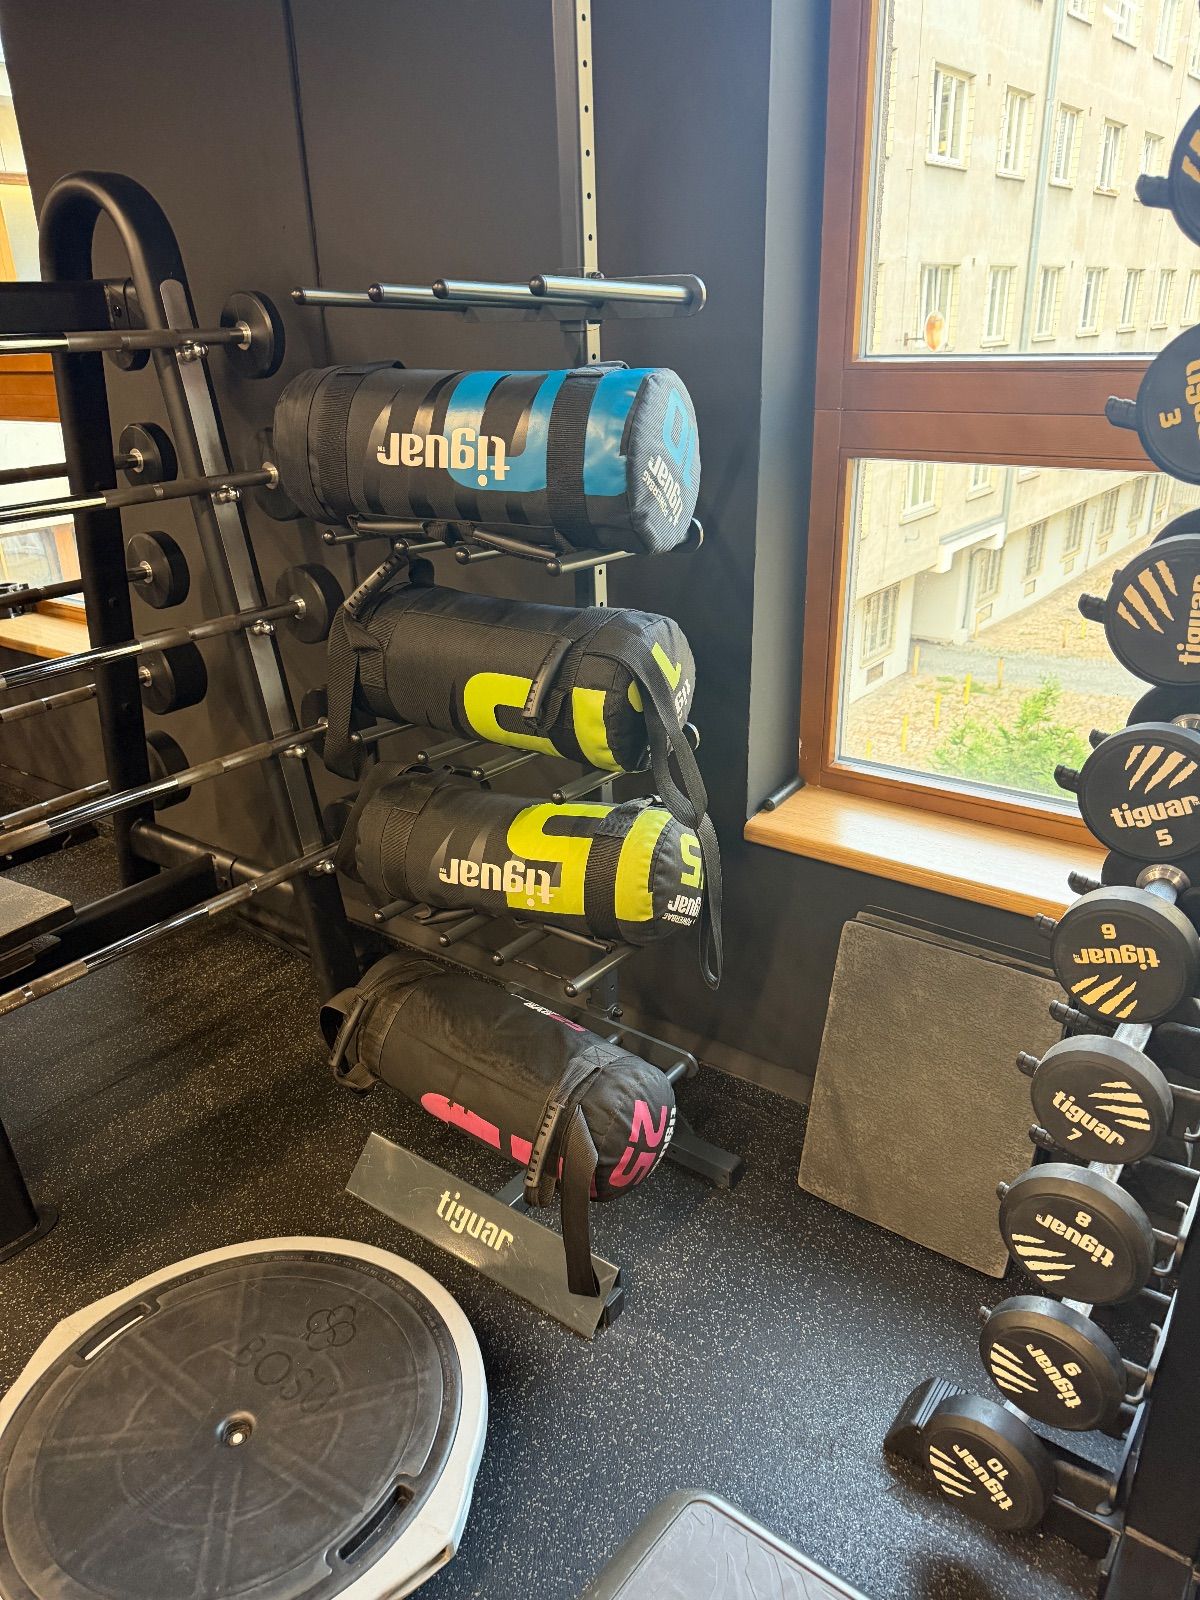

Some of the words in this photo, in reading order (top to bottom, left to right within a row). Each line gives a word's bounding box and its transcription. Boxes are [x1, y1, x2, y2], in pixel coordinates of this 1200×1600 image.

[1159, 407, 1182, 429] 3
[376, 427, 511, 487] tiguar
[1110, 795, 1200, 828] tiguar
[1155, 828, 1174, 847] 5
[438, 858, 555, 907] tiguar
[667, 894, 702, 918] guar
[1101, 923, 1117, 940] 6
[1073, 944, 1160, 971] tiguar
[1052, 1090, 1126, 1146] tiguar
[1066, 1127, 1083, 1141] 7
[608, 1099, 669, 1188] 25
[436, 1190, 515, 1252] tiguar
[1075, 1210, 1093, 1228] 8
[1035, 1213, 1116, 1269] tiguar
[229, 1335, 340, 1415] BOSU
[1025, 1343, 1082, 1410] tiguar
[1062, 1361, 1083, 1377] 9
[952, 1444, 1014, 1512] tiguar
[986, 1457, 1010, 1481] 10
